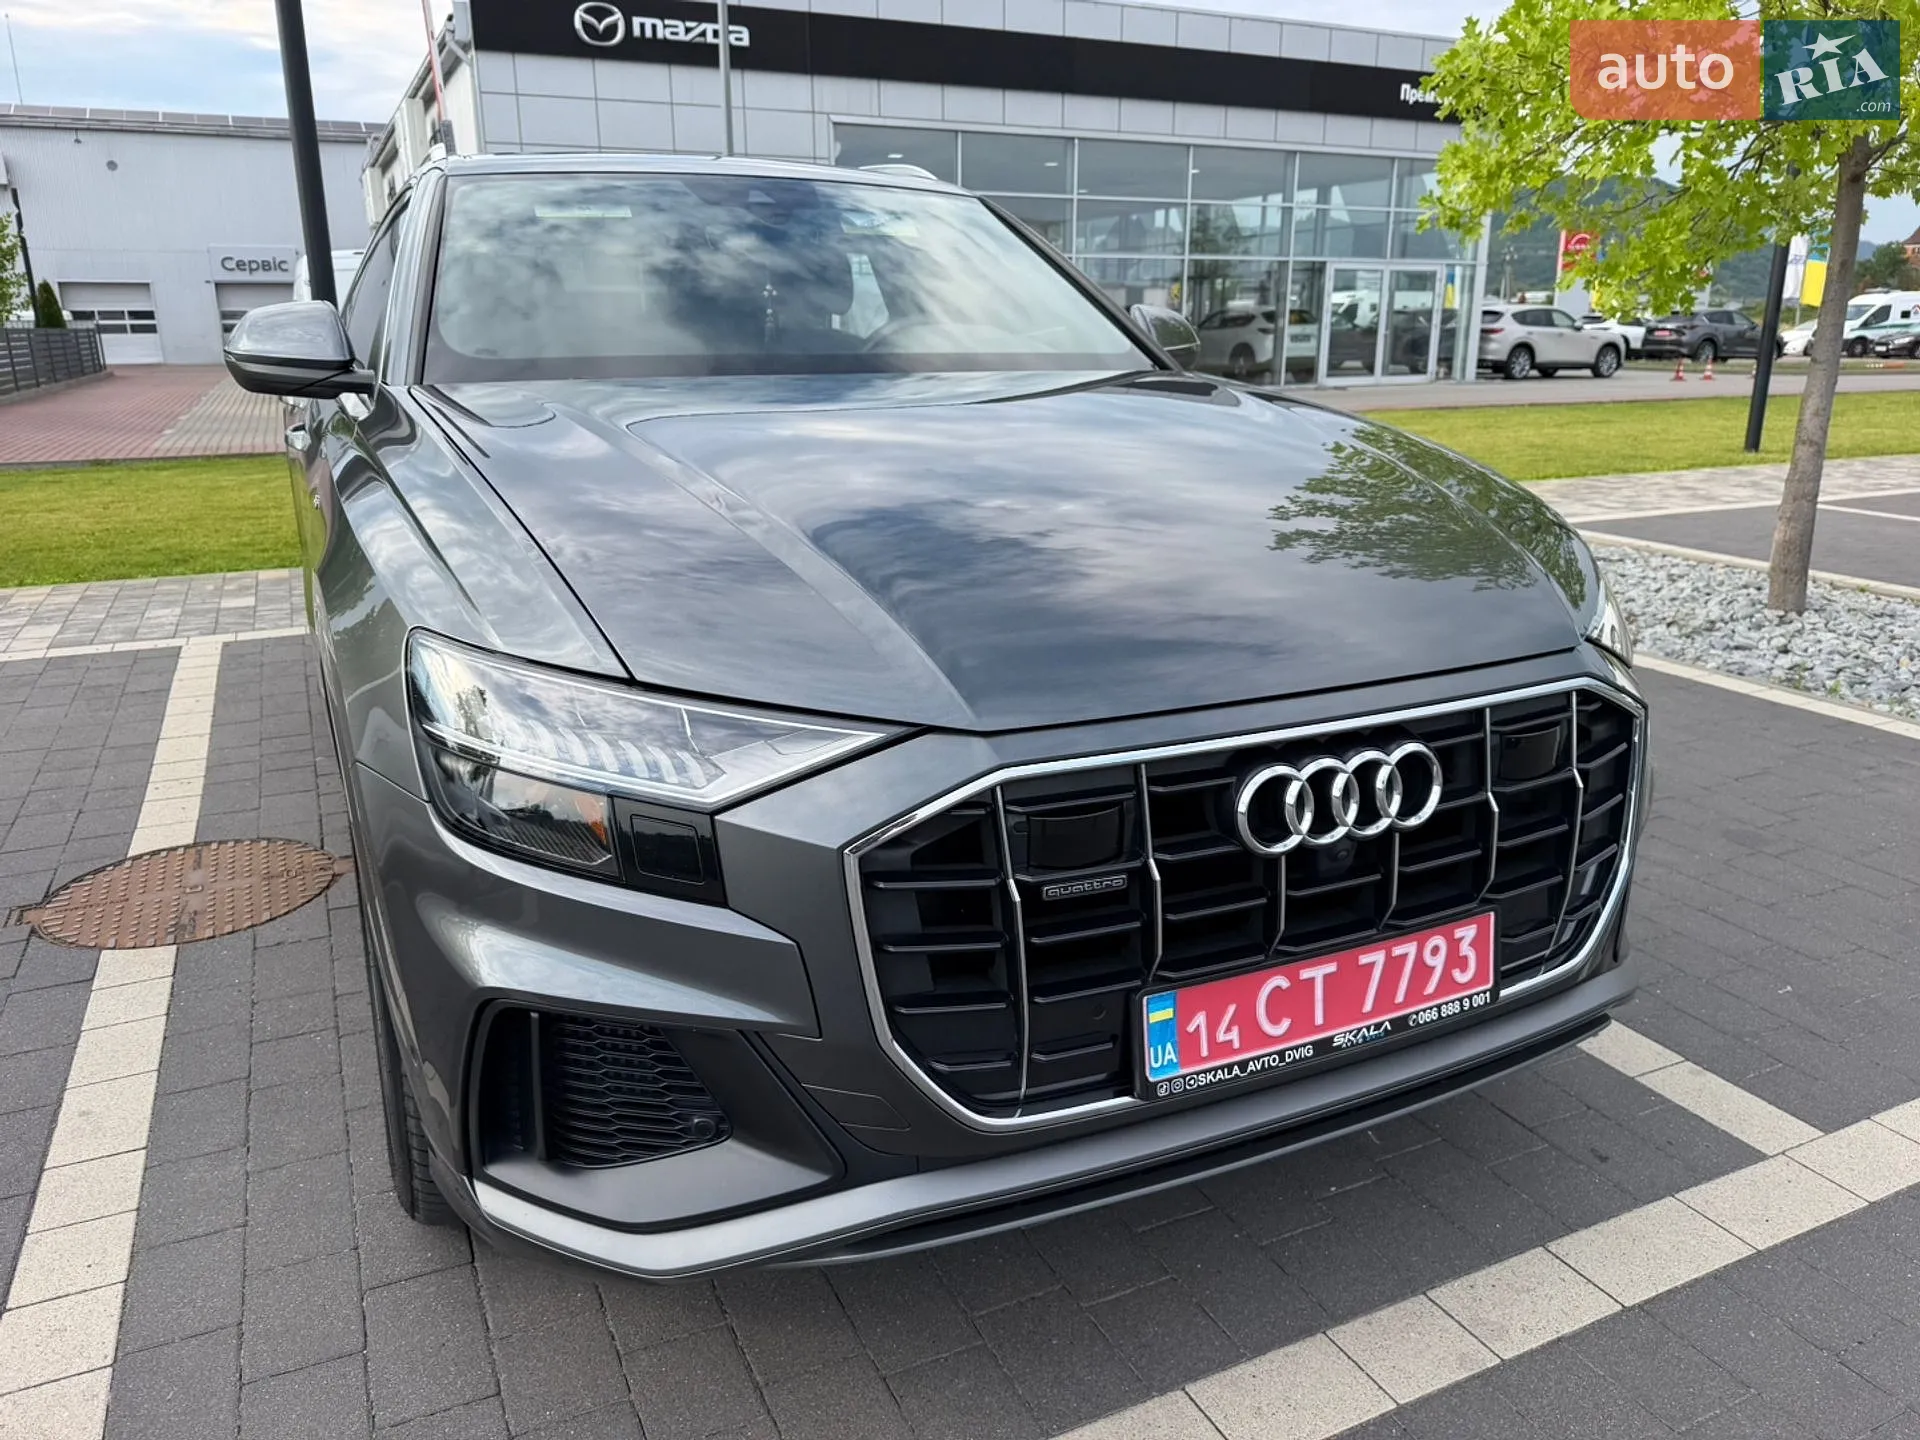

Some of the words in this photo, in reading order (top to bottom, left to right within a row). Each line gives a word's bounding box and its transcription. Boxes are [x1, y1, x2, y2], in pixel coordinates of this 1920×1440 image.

[632, 16, 750, 47] mazda
[221, 256, 289, 275] Сервіс
[1047, 879, 1124, 897] quattro
[1358, 924, 1478, 1014] 7793
[1418, 1007, 1439, 1025] 066
[1440, 1000, 1461, 1018] 888
[1471, 991, 1491, 1008] 001
[1150, 1042, 1177, 1068] UA
